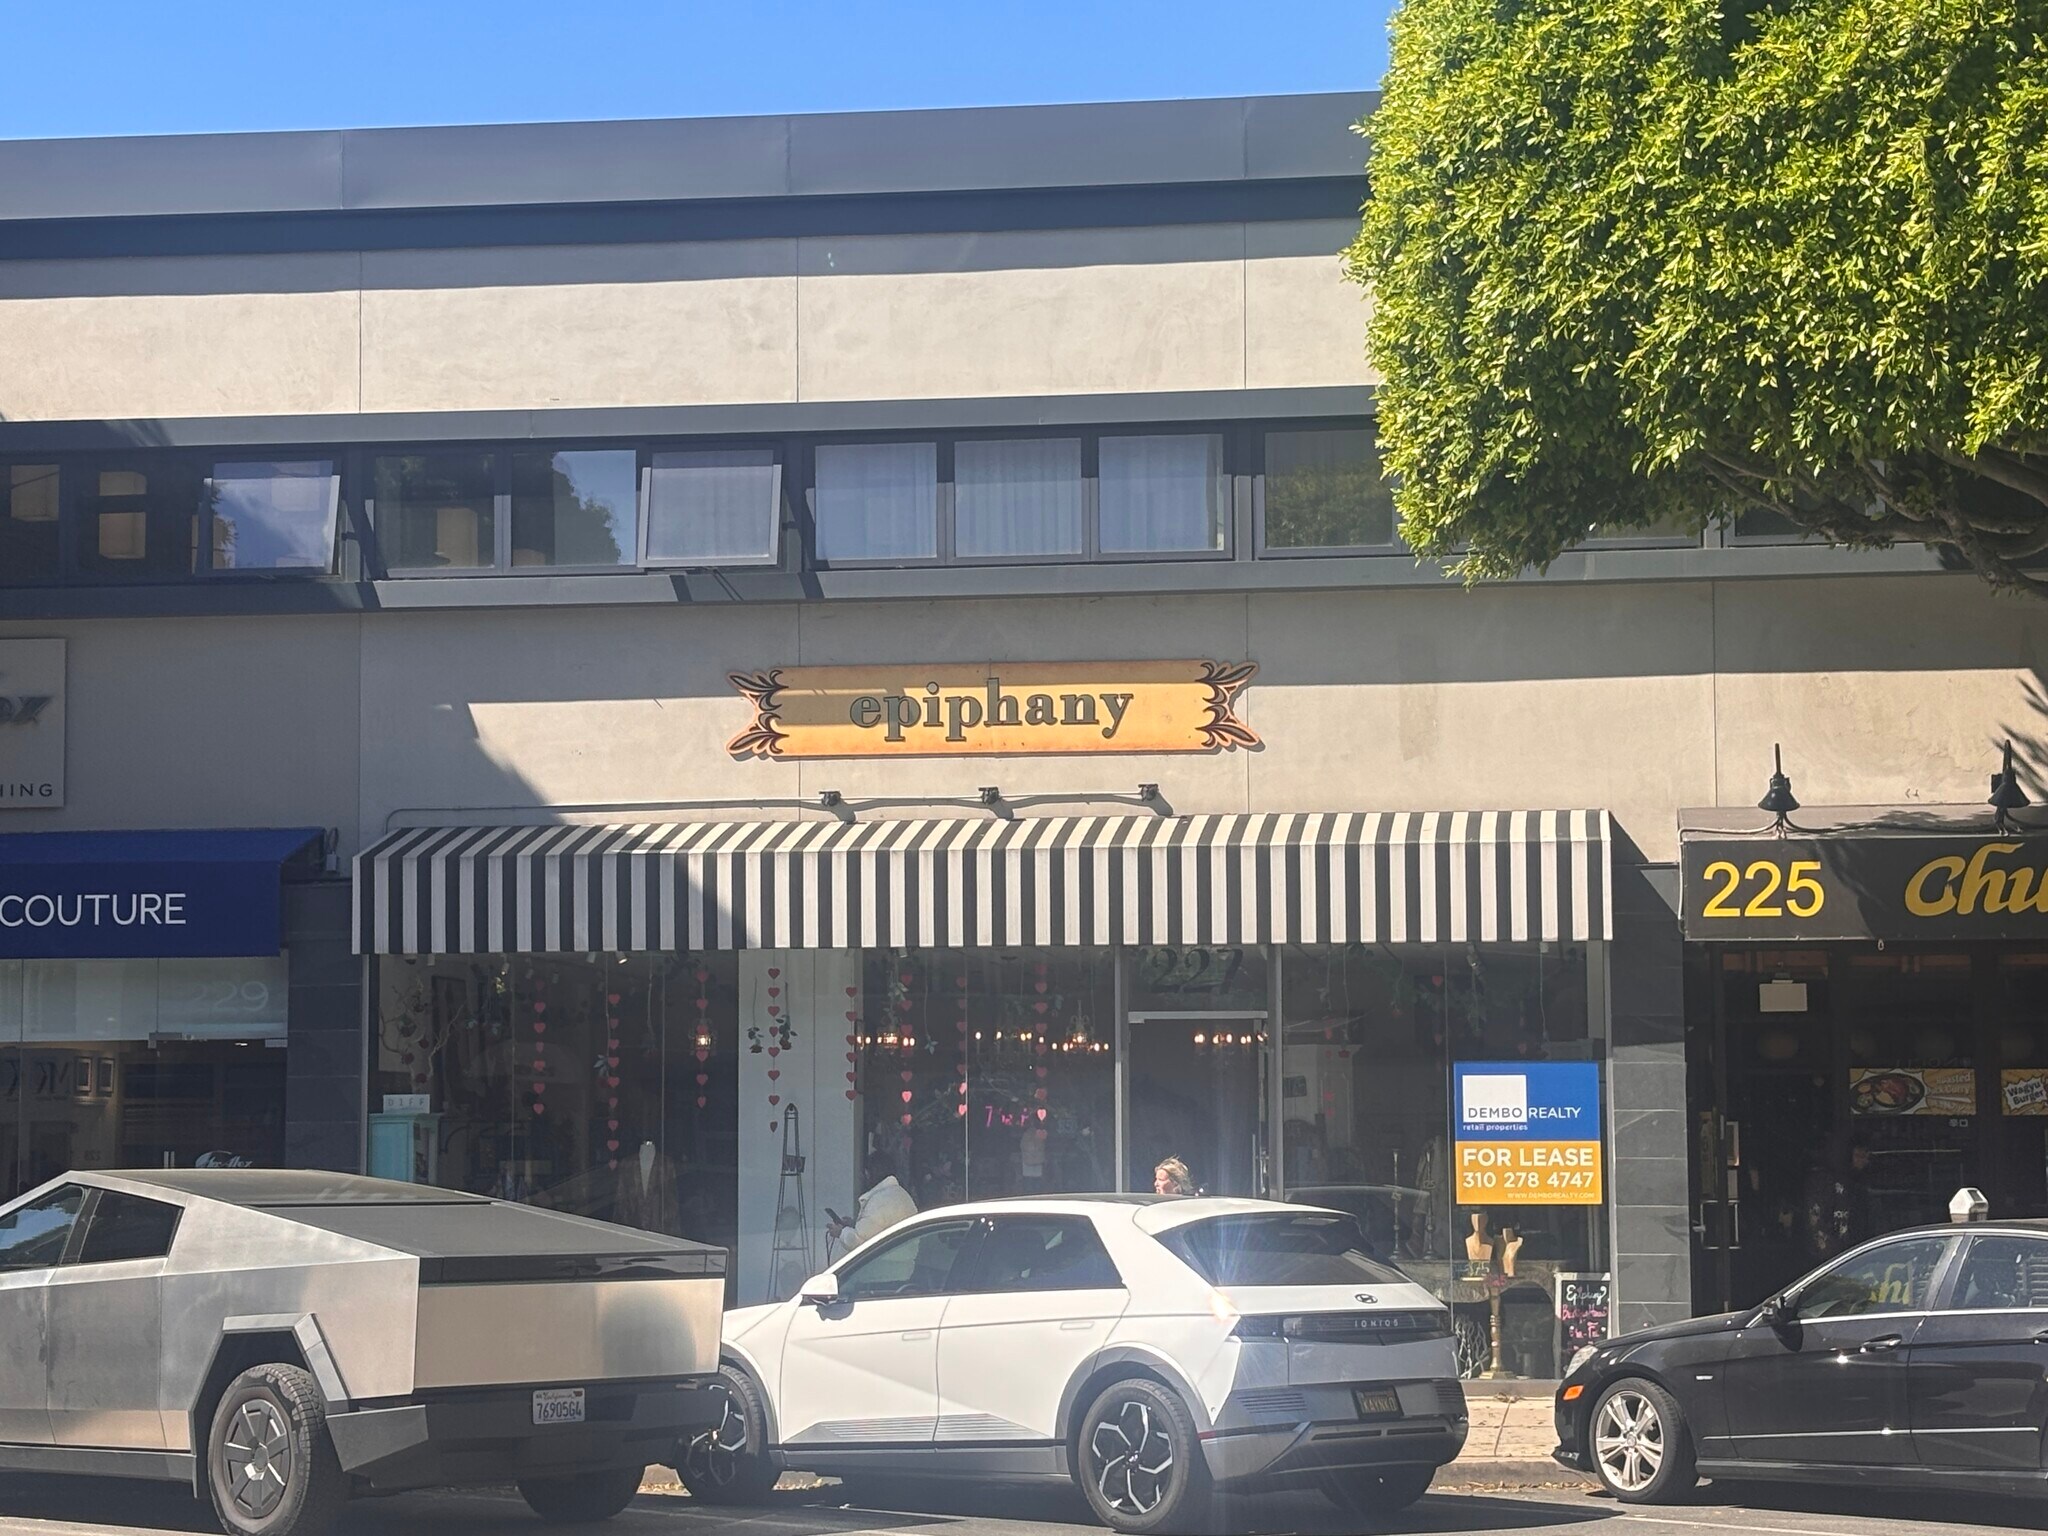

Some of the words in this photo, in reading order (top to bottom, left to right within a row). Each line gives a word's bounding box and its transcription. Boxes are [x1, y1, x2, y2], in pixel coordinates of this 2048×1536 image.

[849, 677, 1135, 742] epiphany
[0, 783, 53, 797] ING
[1702, 860, 1825, 917] 225
[0, 893, 187, 927] COUTURE
[1150, 947, 1244, 993] 227
[2007, 1081, 2041, 1097] Wagyu
[2013, 1089, 2044, 1105] Burger
[1468, 1107, 1523, 1118] DEMBO
[1528, 1107, 1582, 1118] REALTY
[1463, 1123, 1485, 1131] retail
[1486, 1123, 1529, 1132] properties
[1463, 1148, 1512, 1167] FOR
[1519, 1148, 1594, 1167] LEASE
[1463, 1172, 1497, 1188] 310
[1503, 1172, 1540, 1188] 278
[1546, 1172, 1594, 1188] 4747
